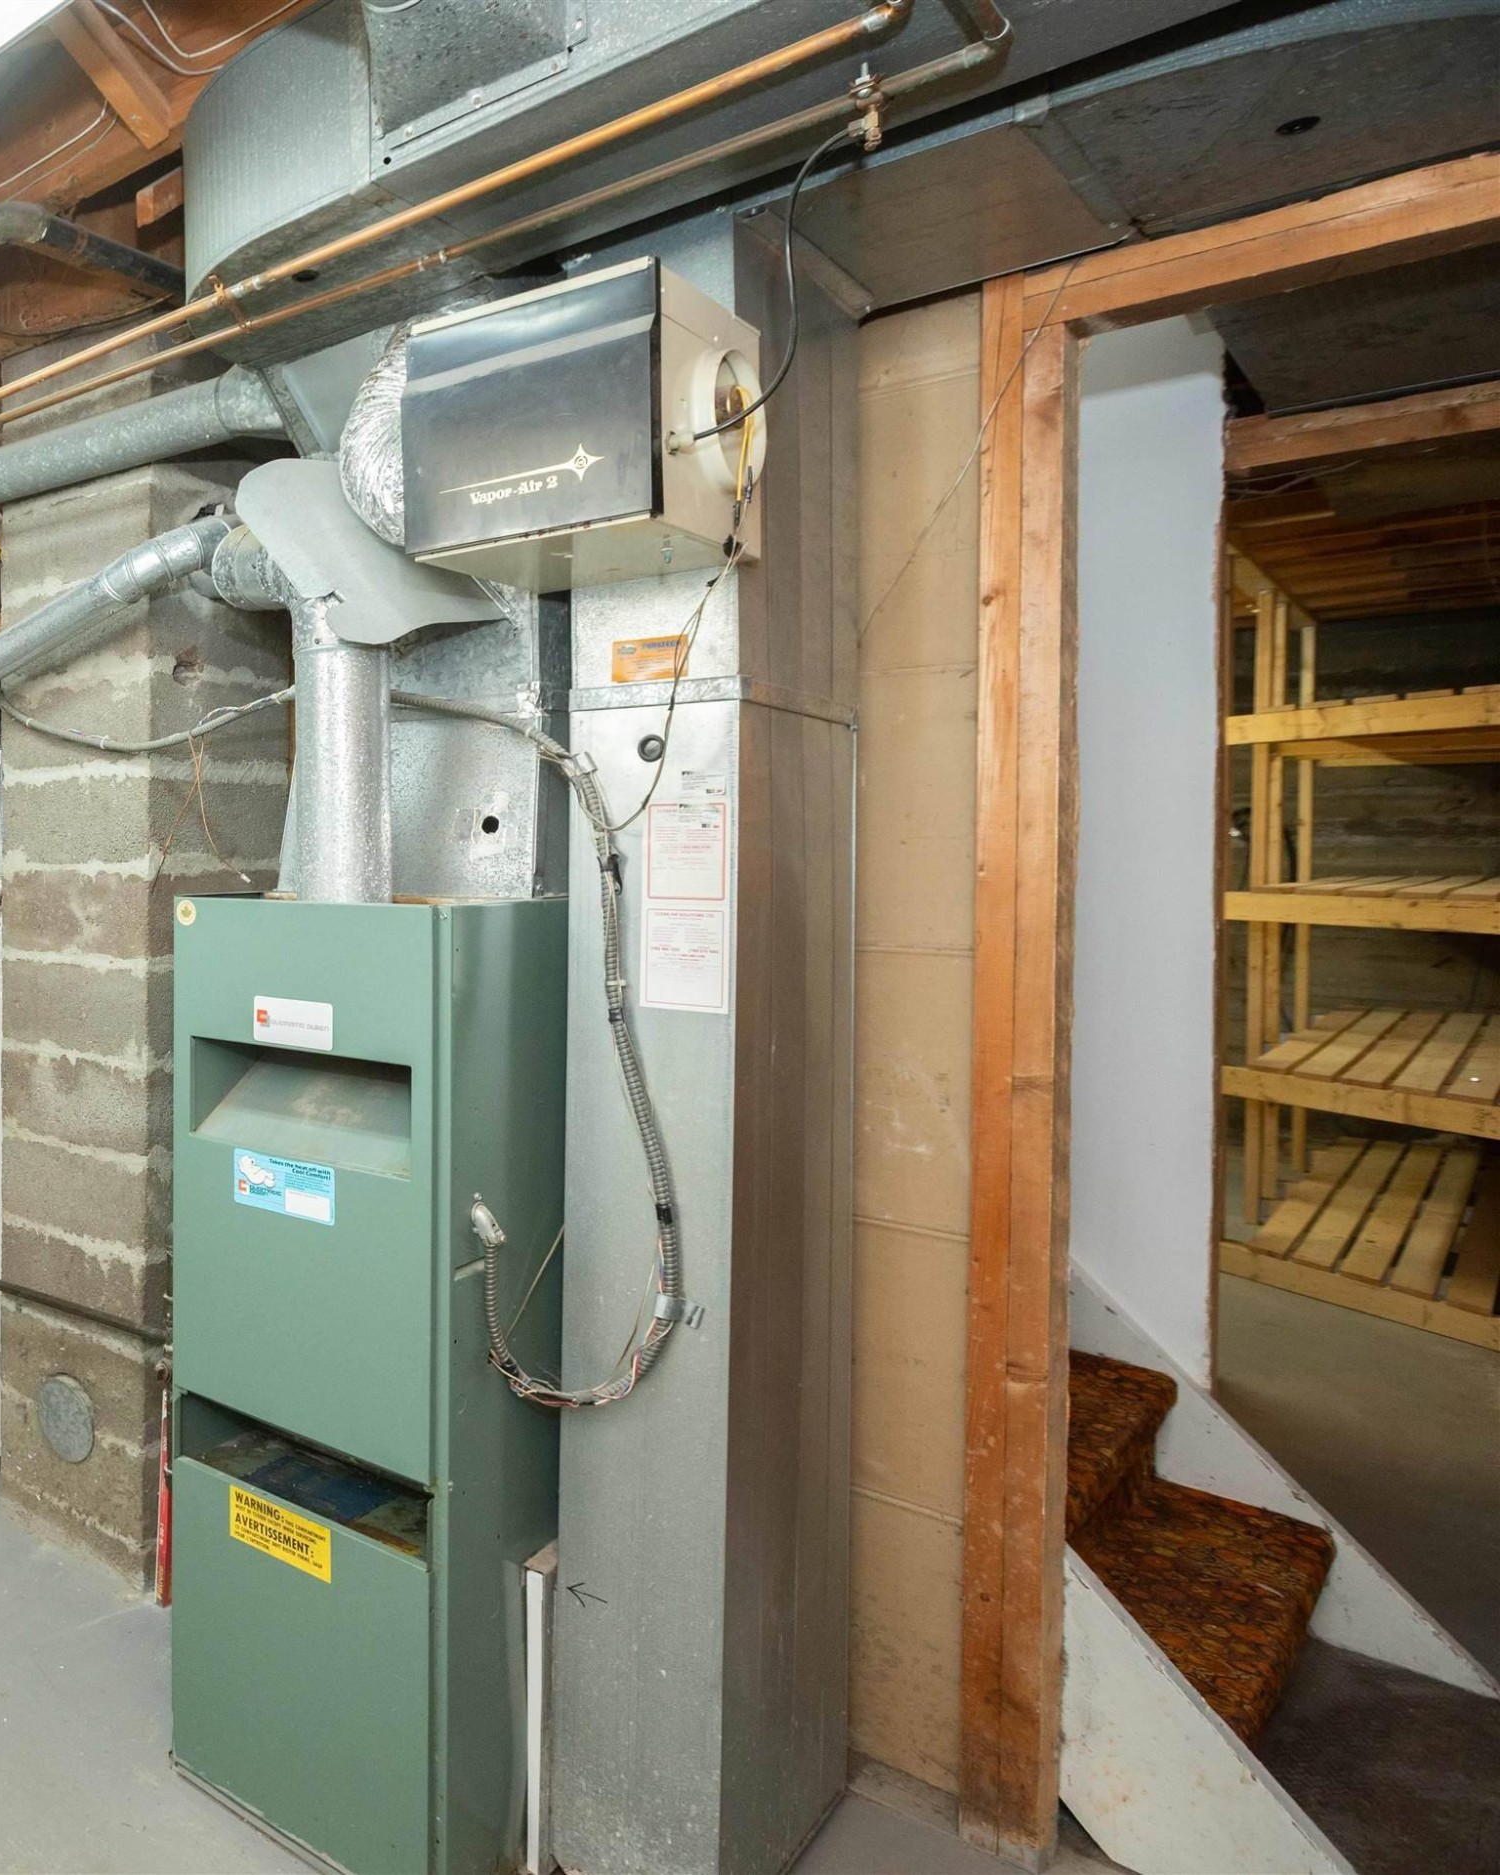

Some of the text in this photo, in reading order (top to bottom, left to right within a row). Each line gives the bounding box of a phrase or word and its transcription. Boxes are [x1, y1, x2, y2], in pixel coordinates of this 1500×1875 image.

[470, 475, 558, 505] Vapor-Air 2
[317, 1168, 331, 1176] with
[235, 1491, 284, 1523] WARNING:
